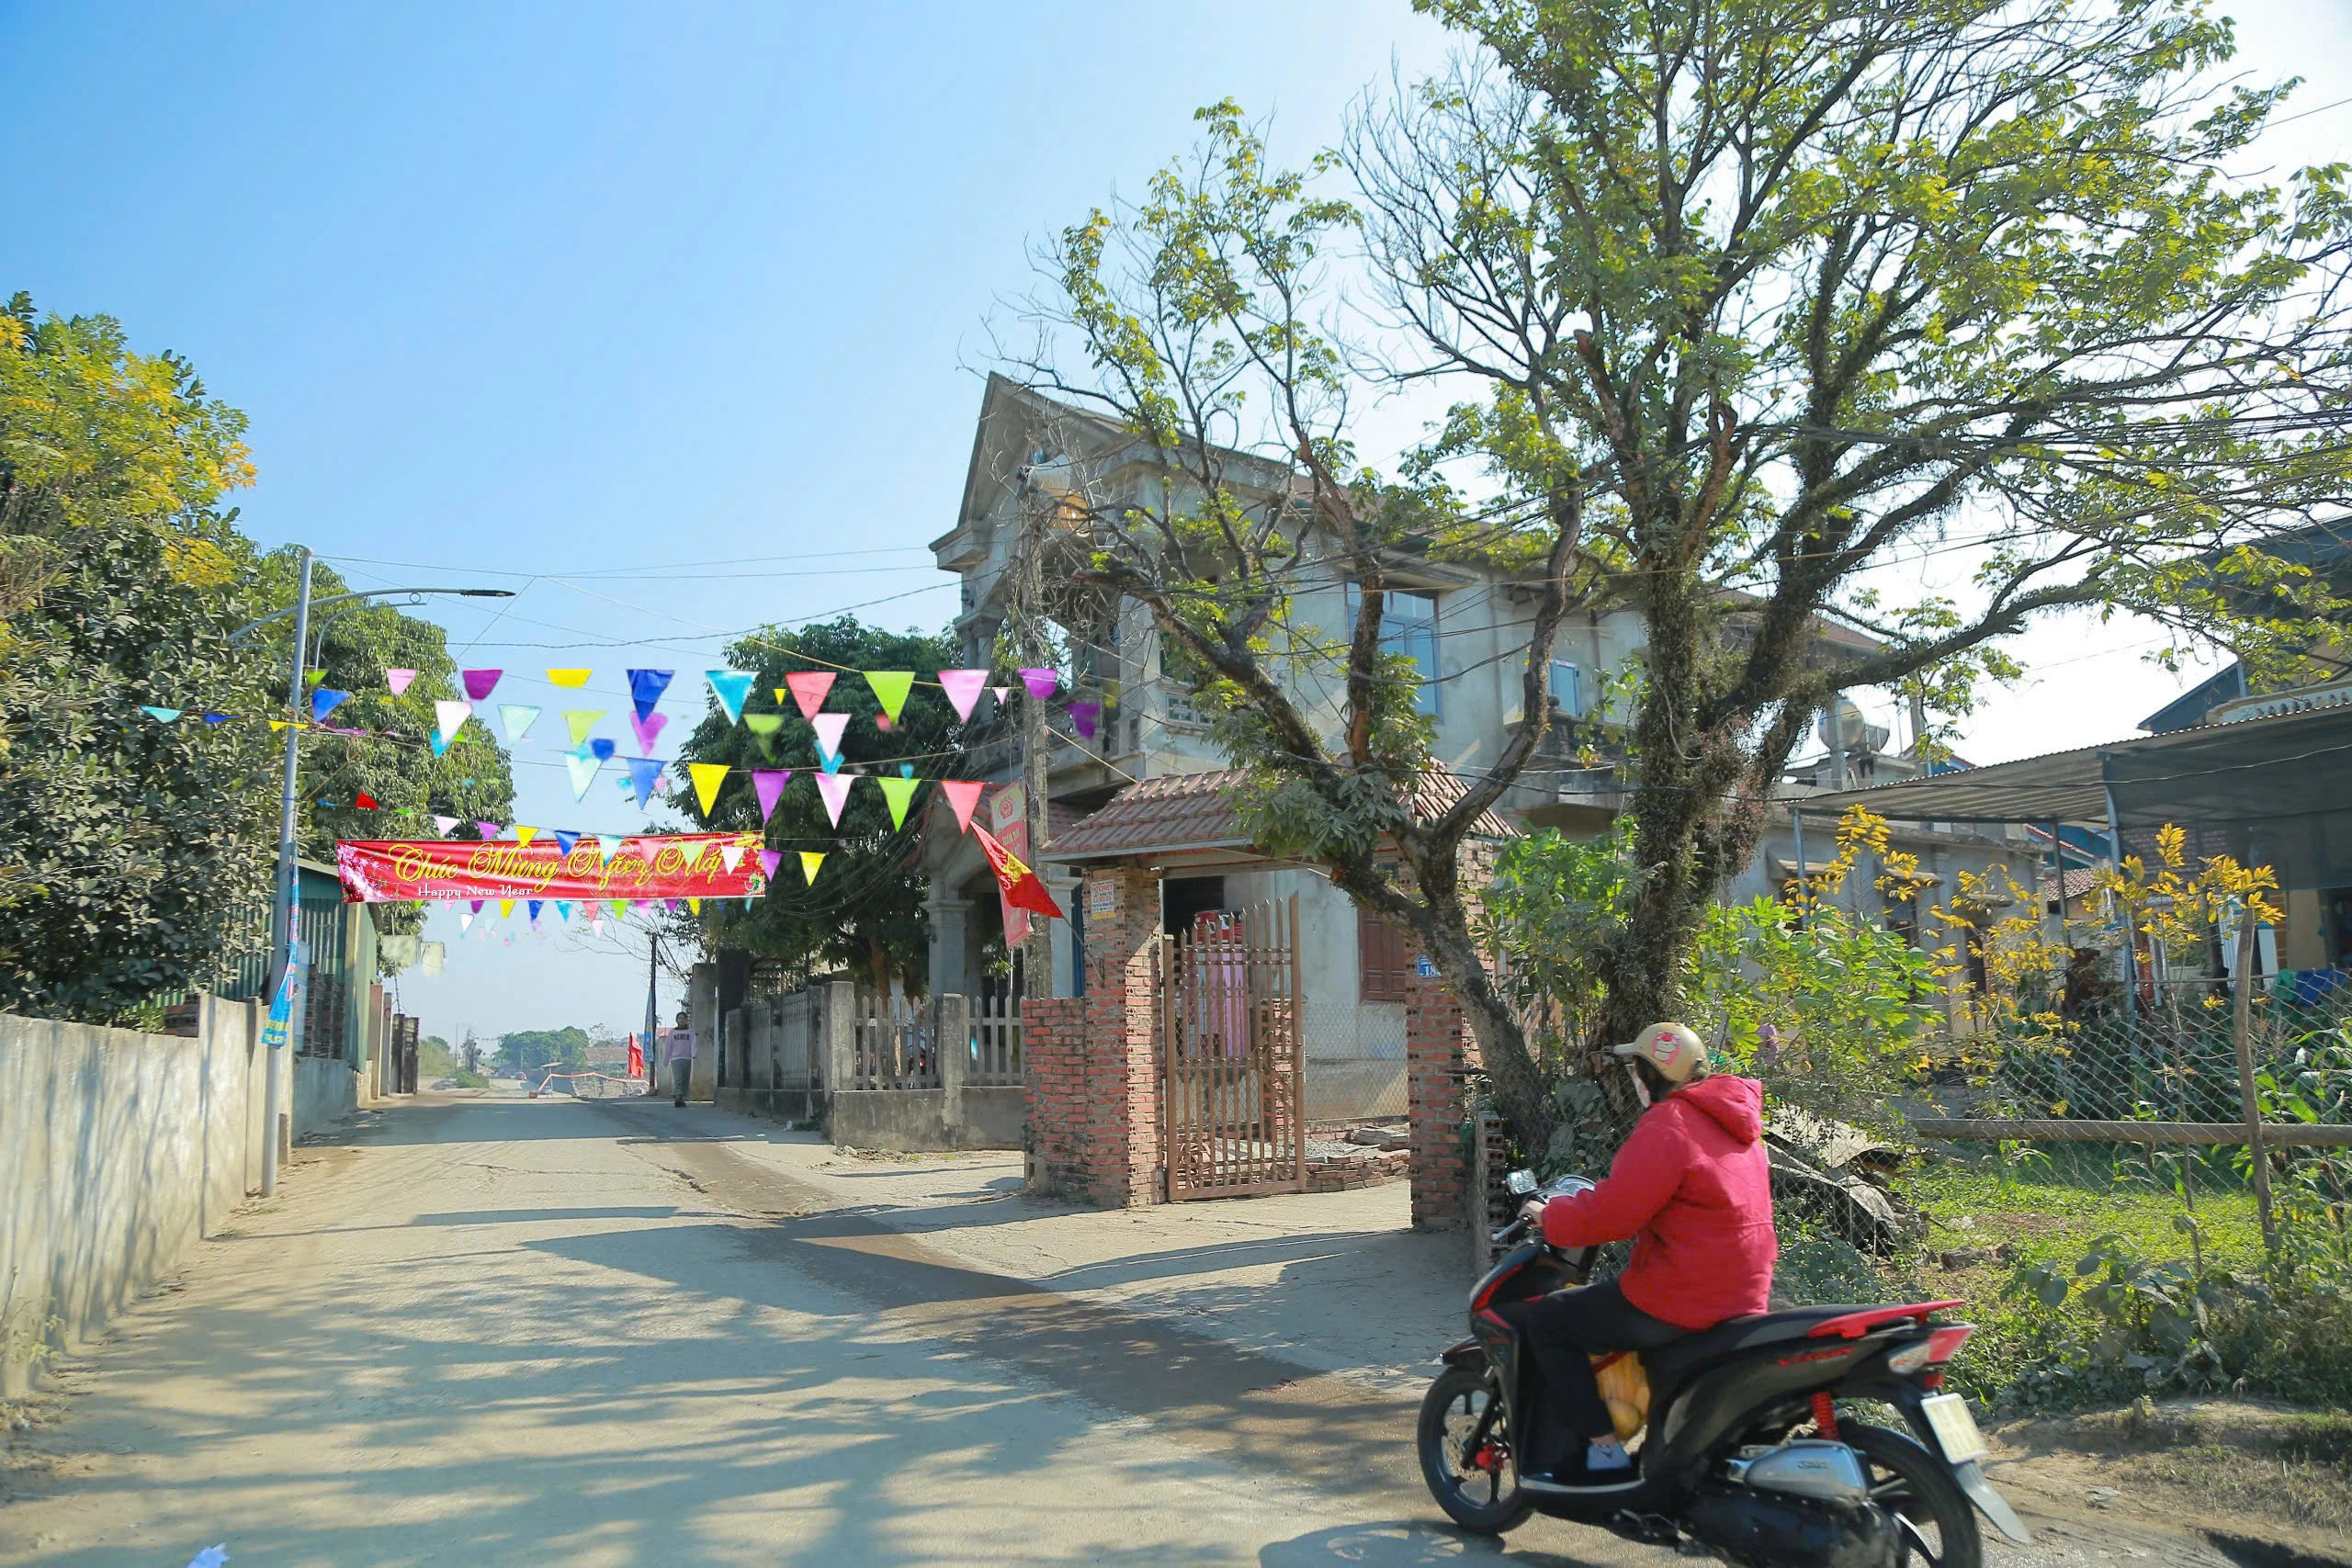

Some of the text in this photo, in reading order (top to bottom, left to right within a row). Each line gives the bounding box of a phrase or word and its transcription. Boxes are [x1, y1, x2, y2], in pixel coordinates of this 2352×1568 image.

[389, 843, 459, 882] Chúc
[468, 842, 560, 893] Mừng
[418, 884, 534, 899] Happy New Year
